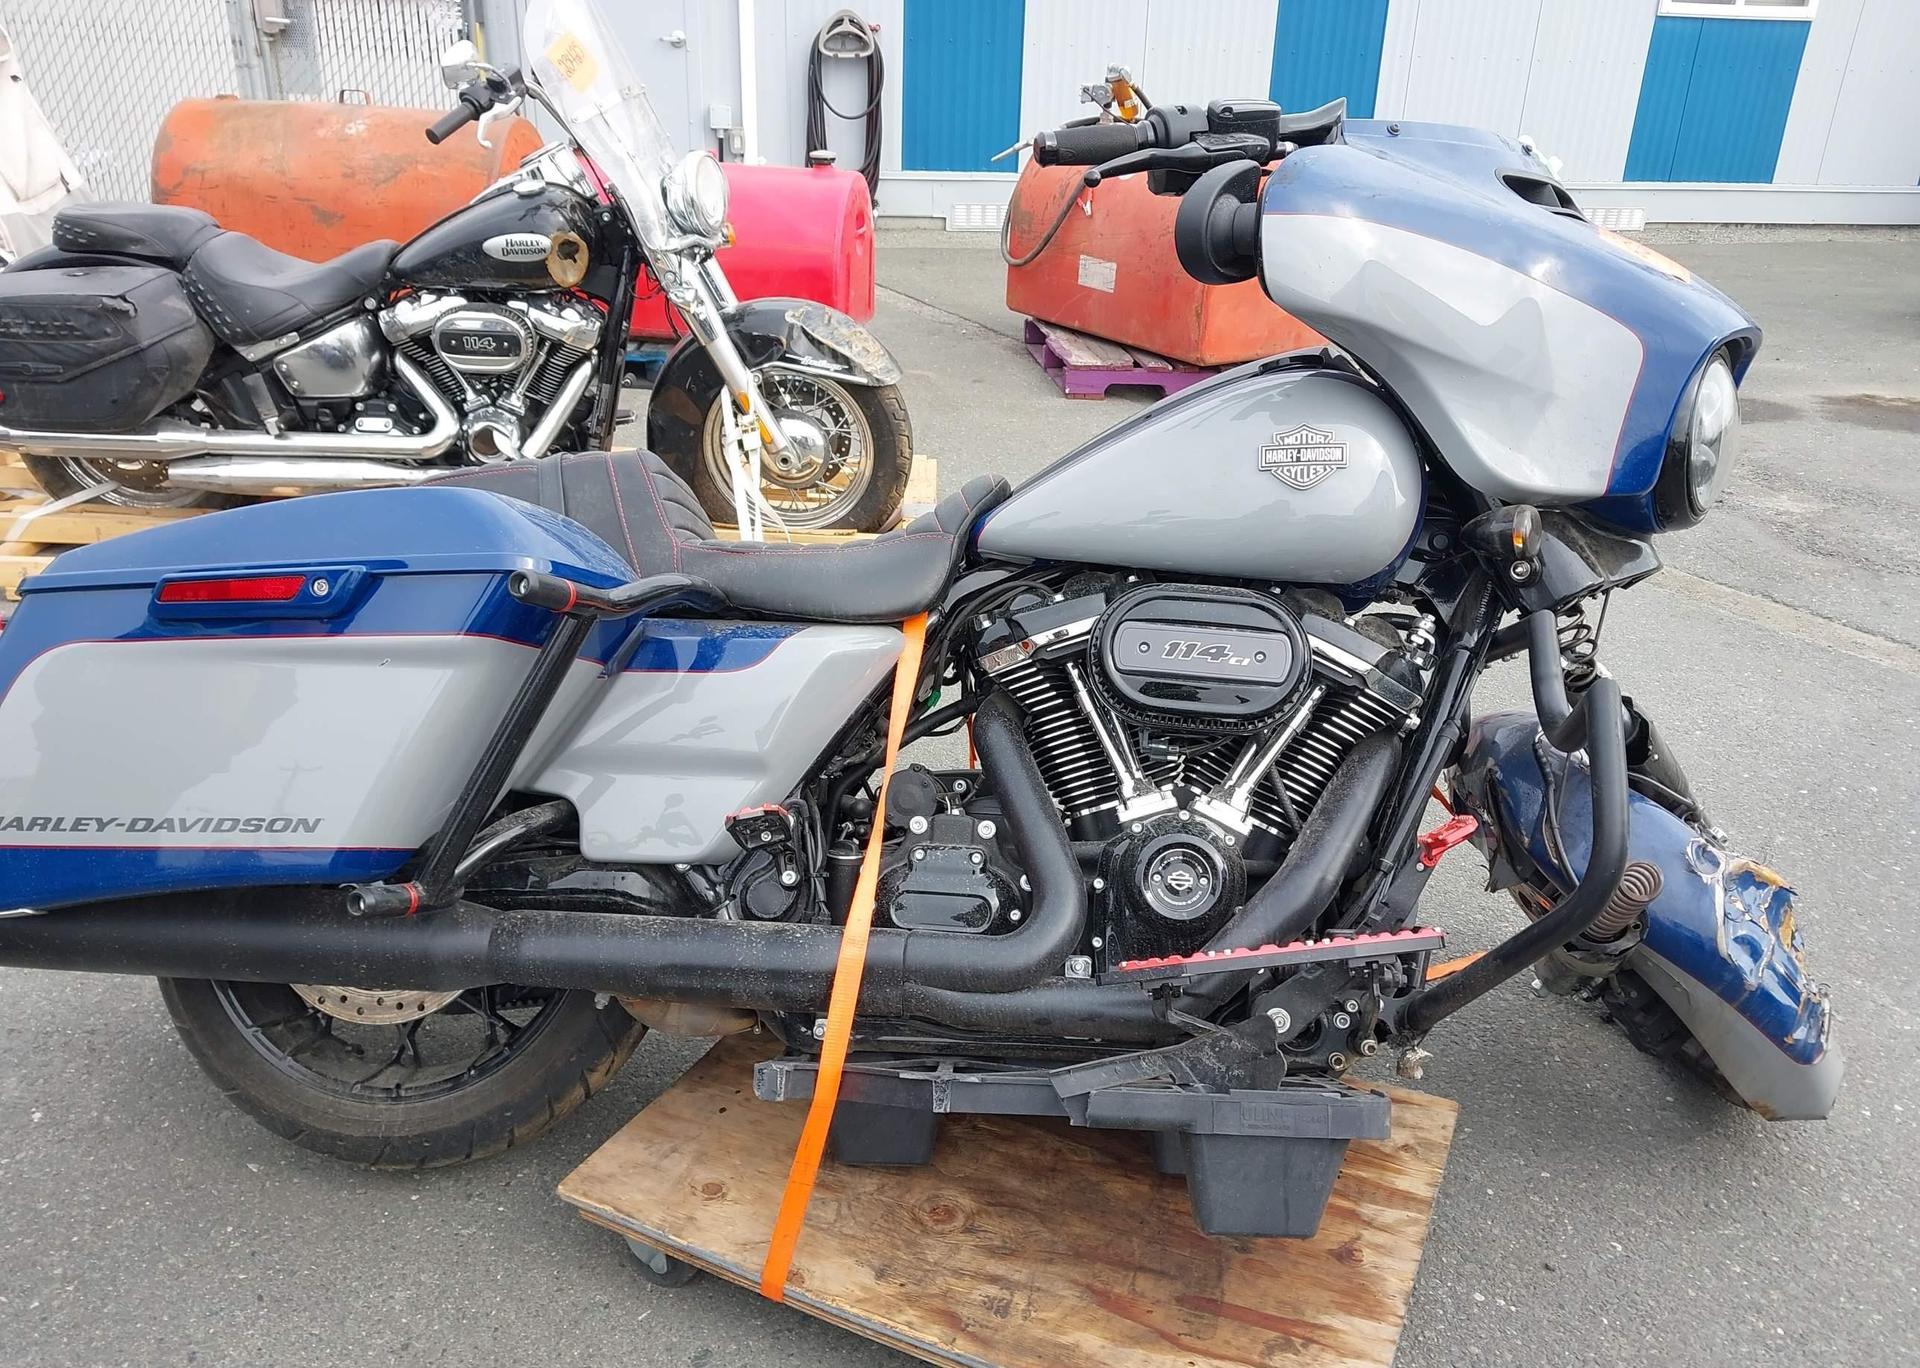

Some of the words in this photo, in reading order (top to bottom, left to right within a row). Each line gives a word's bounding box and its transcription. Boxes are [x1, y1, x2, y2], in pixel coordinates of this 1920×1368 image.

[501, 247, 547, 257] DAVIDSON
[462, 336, 497, 349] 114
[1284, 431, 1326, 445] MOTOR
[1265, 447, 1343, 463] HARLEY-DAVIDSON
[1283, 465, 1326, 483] CYCLES
